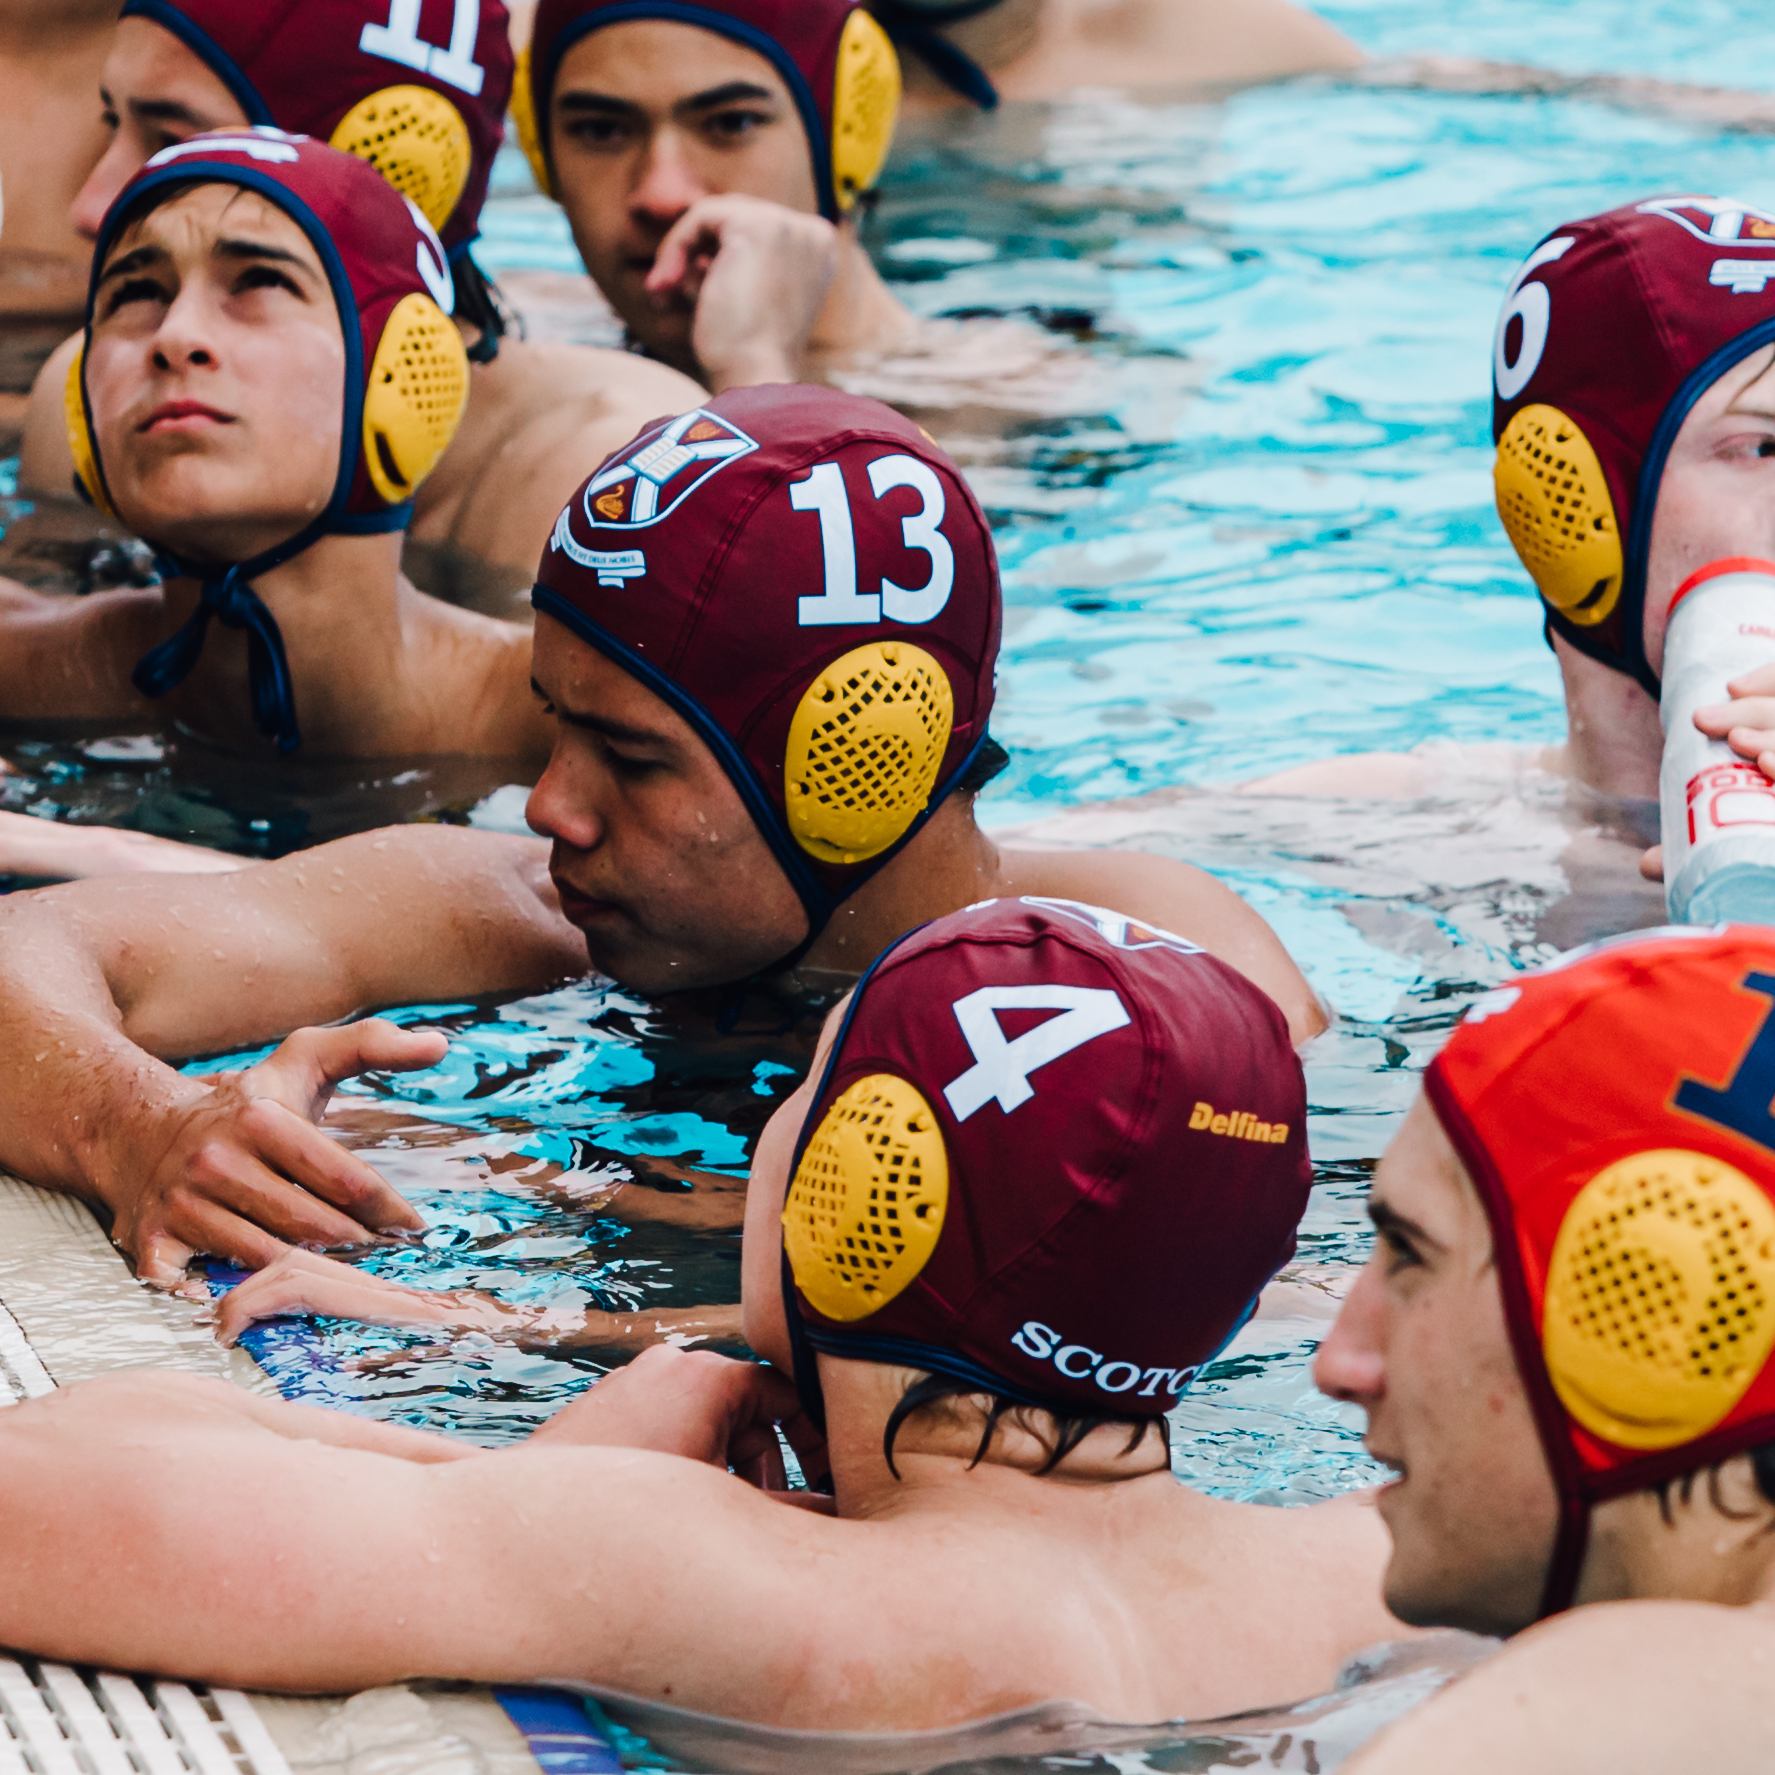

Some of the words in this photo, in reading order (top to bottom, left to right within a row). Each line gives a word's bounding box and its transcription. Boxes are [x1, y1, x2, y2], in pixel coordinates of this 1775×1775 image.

[1495, 236, 1576, 401] 6
[789, 454, 955, 625] 13
[942, 984, 1132, 1123] 4
[1188, 1101, 1290, 1144] Delfina
[1010, 1320, 1213, 1397] SCOTC
